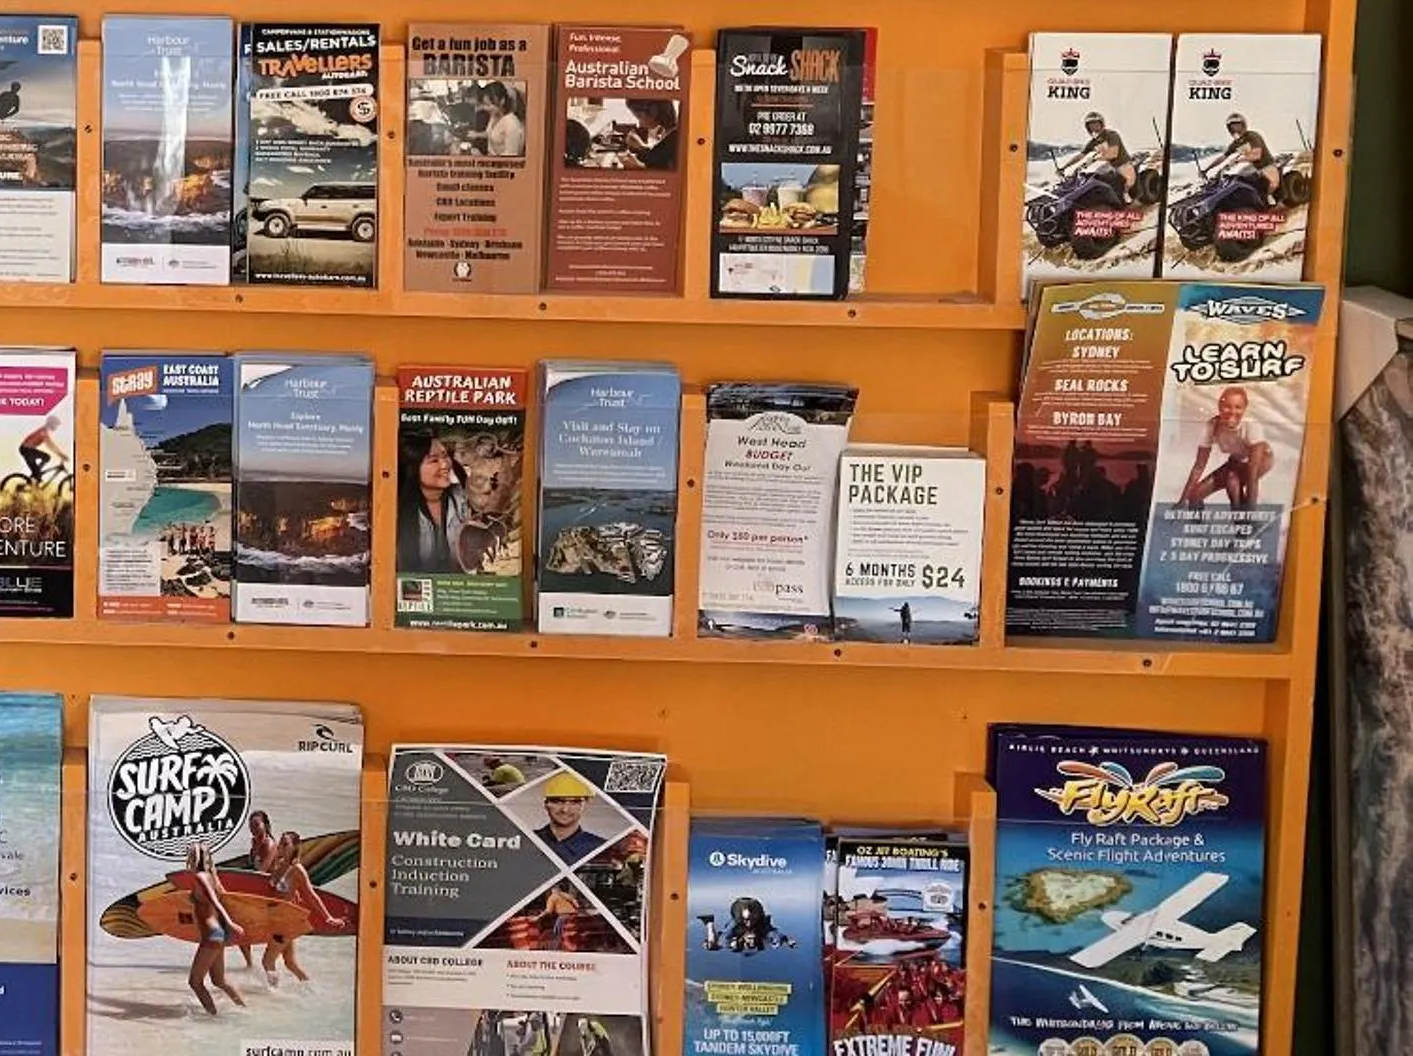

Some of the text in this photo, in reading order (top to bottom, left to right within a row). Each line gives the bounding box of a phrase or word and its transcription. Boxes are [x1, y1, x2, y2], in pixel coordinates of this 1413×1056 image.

[257, 36, 376, 54] SALES/RENTALS
[423, 53, 514, 76] BARISTA
[565, 60, 648, 75] Australian
[730, 54, 788, 76] Snack
[565, 75, 680, 90] Barista School
[1047, 87, 1090, 99] KING
[1188, 88, 1231, 100] KING
[1072, 346, 1120, 359] SYDNEY
[1185, 342, 1287, 363] LEARN
[164, 364, 218, 375] EAST COAST
[1173, 358, 1304, 381] TO SURF
[164, 375, 219, 386] AUSTRALIA
[412, 375, 511, 390] AUSTRALIAN
[1054, 379, 1128, 392] SEAL ROCKS
[405, 390, 516, 404] REPTILE PARK
[1053, 413, 1122, 427] BYRON BAY
[850, 464, 922, 483] THE VIP
[849, 485, 938, 505] PACKAGE
[846, 563, 965, 588] 6 MONTHS $24
[299, 741, 352, 753] RIP CURL
[116, 754, 204, 799] SURF
[124, 787, 216, 833] CAMP
[139, 818, 236, 843] AUSTRALIA
[393, 830, 521, 849] White Card
[1071, 833, 1190, 848] Fly Raft Package
[392, 855, 498, 868] Construction
[1048, 848, 1226, 863] Scenic Flight Adventures
[727, 855, 786, 872] Skydive
[392, 870, 469, 881] Induction
[393, 884, 459, 898] Training
